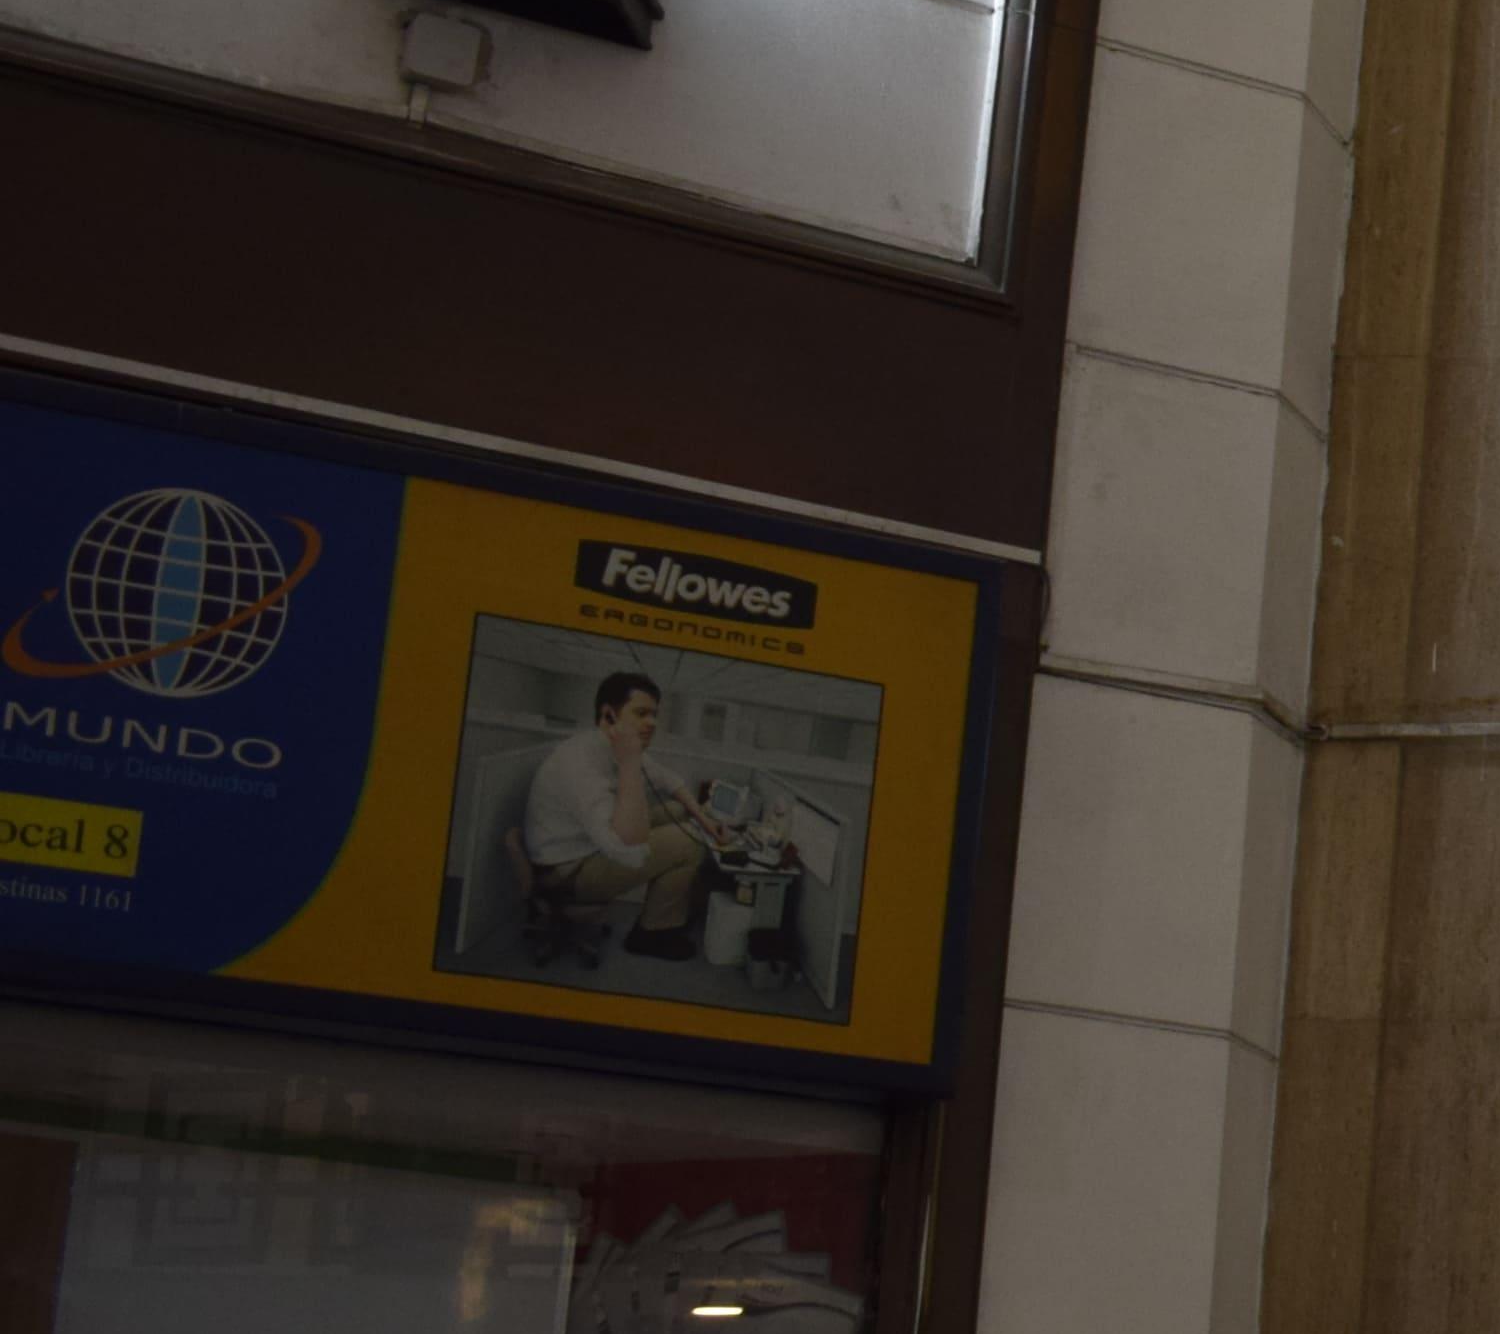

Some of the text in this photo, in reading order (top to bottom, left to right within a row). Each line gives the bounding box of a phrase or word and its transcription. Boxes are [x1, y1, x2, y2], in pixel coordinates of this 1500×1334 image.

[602, 548, 792, 618] Fellowes
[580, 604, 805, 655] ERGONOMICS
[4, 701, 282, 769] MUNDO
[127, 755, 278, 799] Distribuidora
[0, 819, 130, 859] ocal 8
[79, 884, 132, 912] 1161
